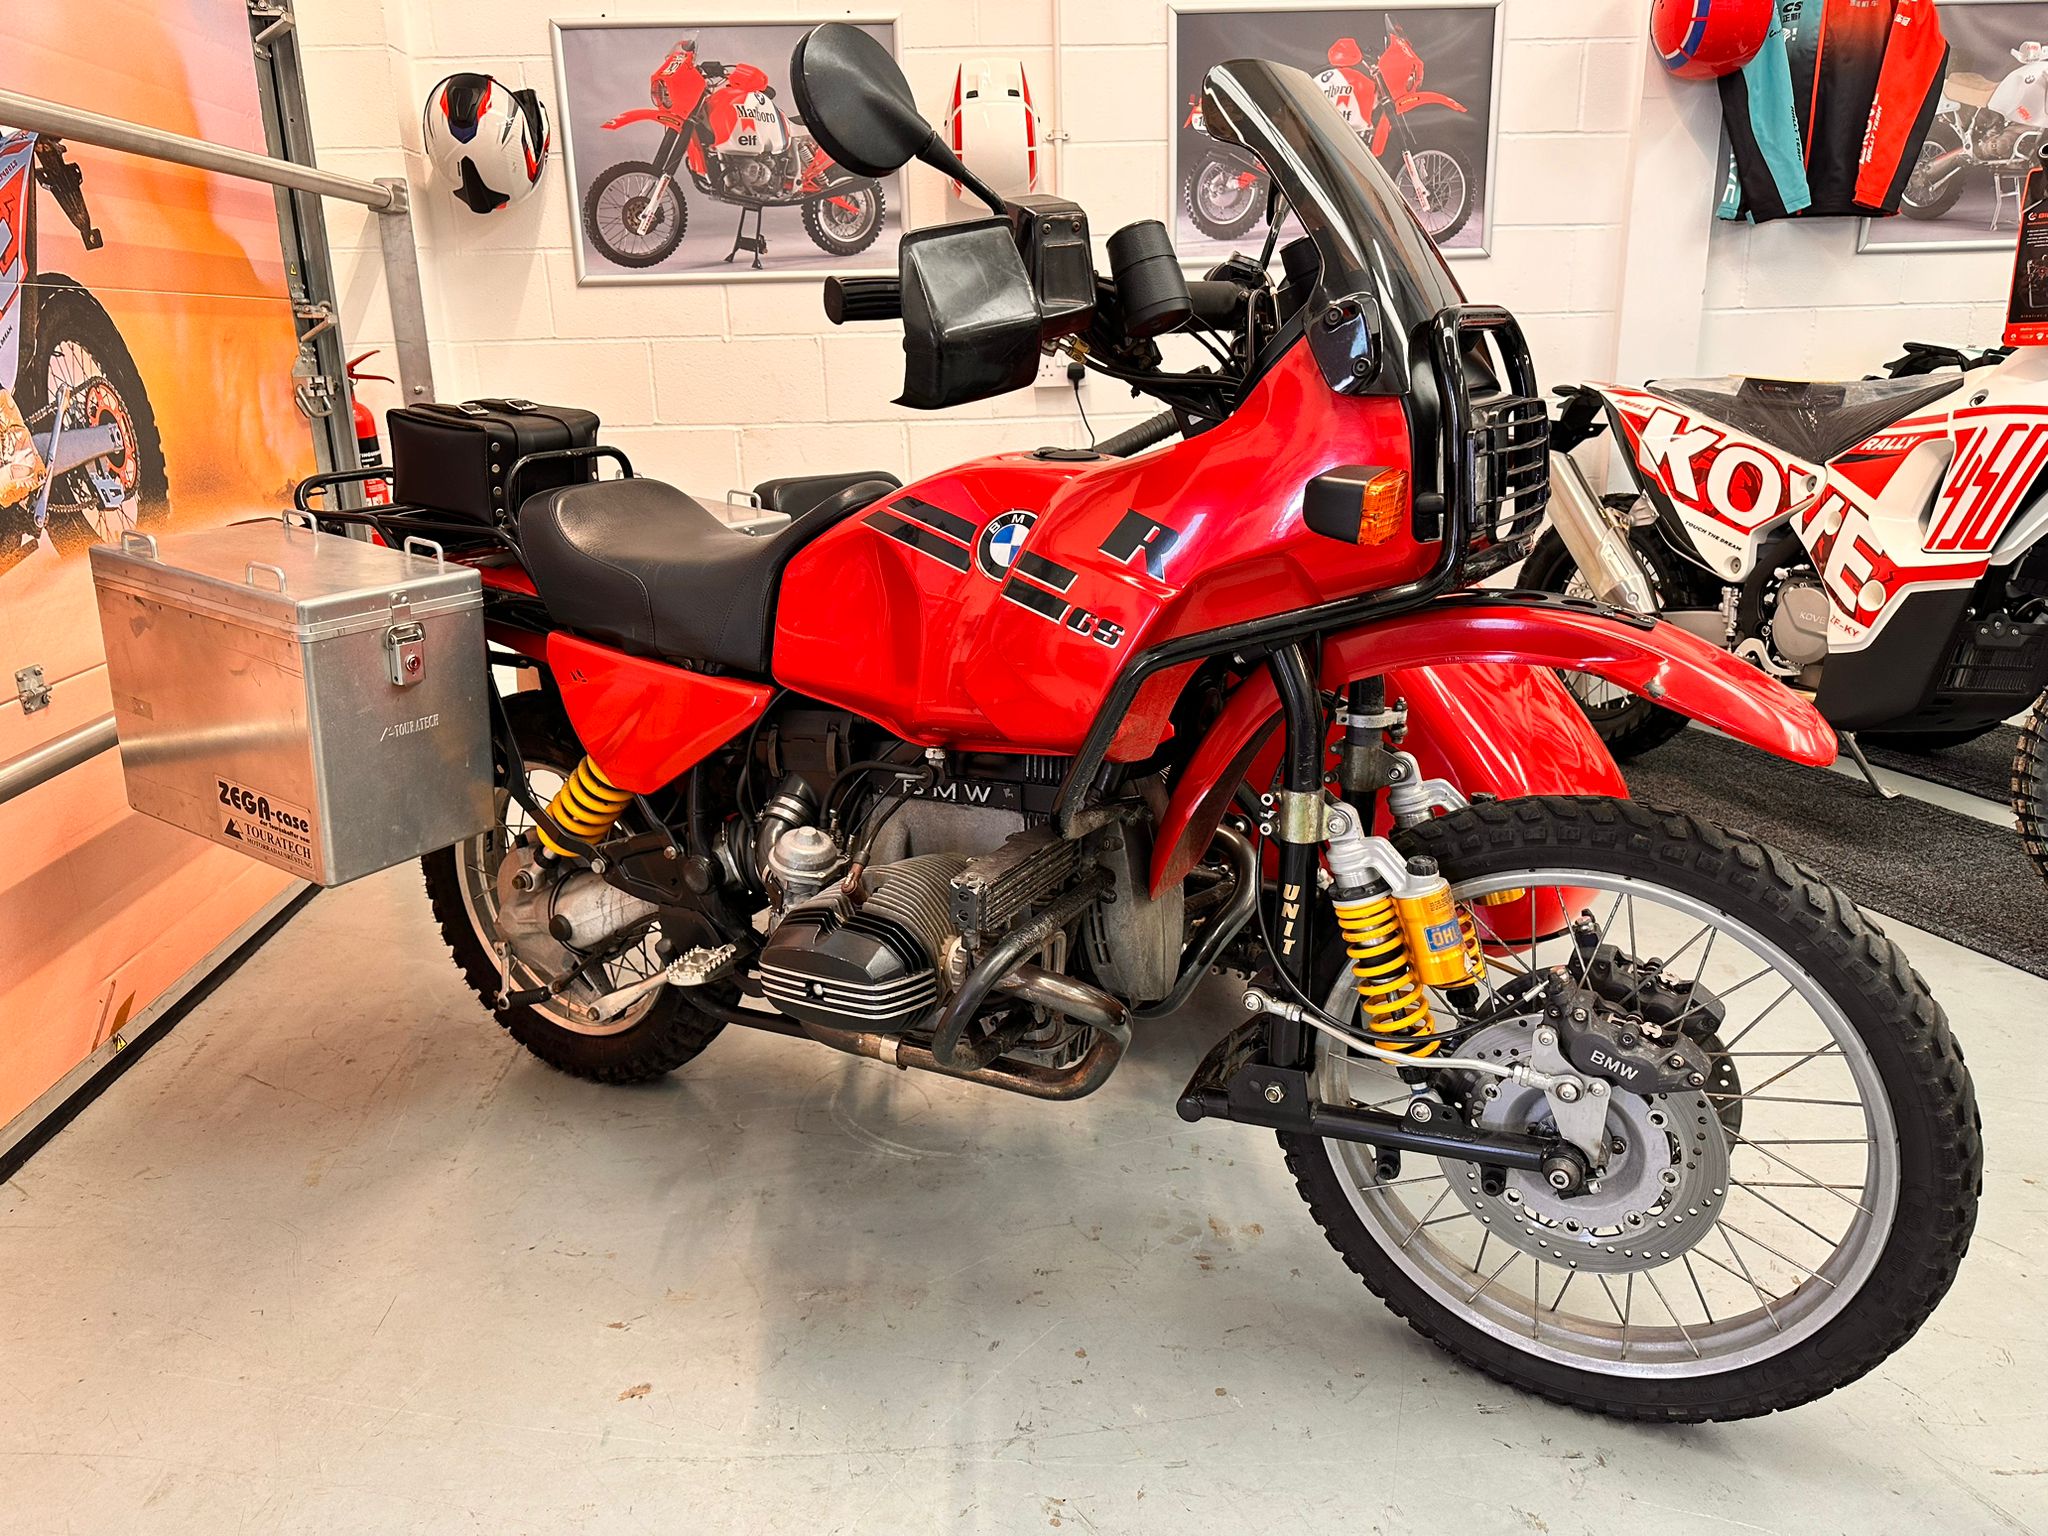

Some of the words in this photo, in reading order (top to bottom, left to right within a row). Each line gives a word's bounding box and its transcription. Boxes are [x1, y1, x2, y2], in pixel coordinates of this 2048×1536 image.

[736, 105, 776, 123] Marlboro
[1342, 110, 1352, 121] lf
[738, 135, 757, 146] elf
[1860, 435, 1921, 450] RALLY
[1925, 423, 2048, 550] 450
[1098, 508, 1181, 583] R
[1685, 520, 1707, 534] TOUCH
[1708, 531, 1720, 541] THE
[1720, 538, 1742, 551] DREAM
[1066, 606, 1126, 649] GS
[1799, 610, 1827, 625] KOVE
[394, 713, 439, 738] TOURATECH
[217, 780, 309, 833] ZEGA-case
[244, 822, 312, 860] TOURATECH
[1281, 883, 1301, 955] UNIT
[1590, 1050, 1639, 1080] BMW
